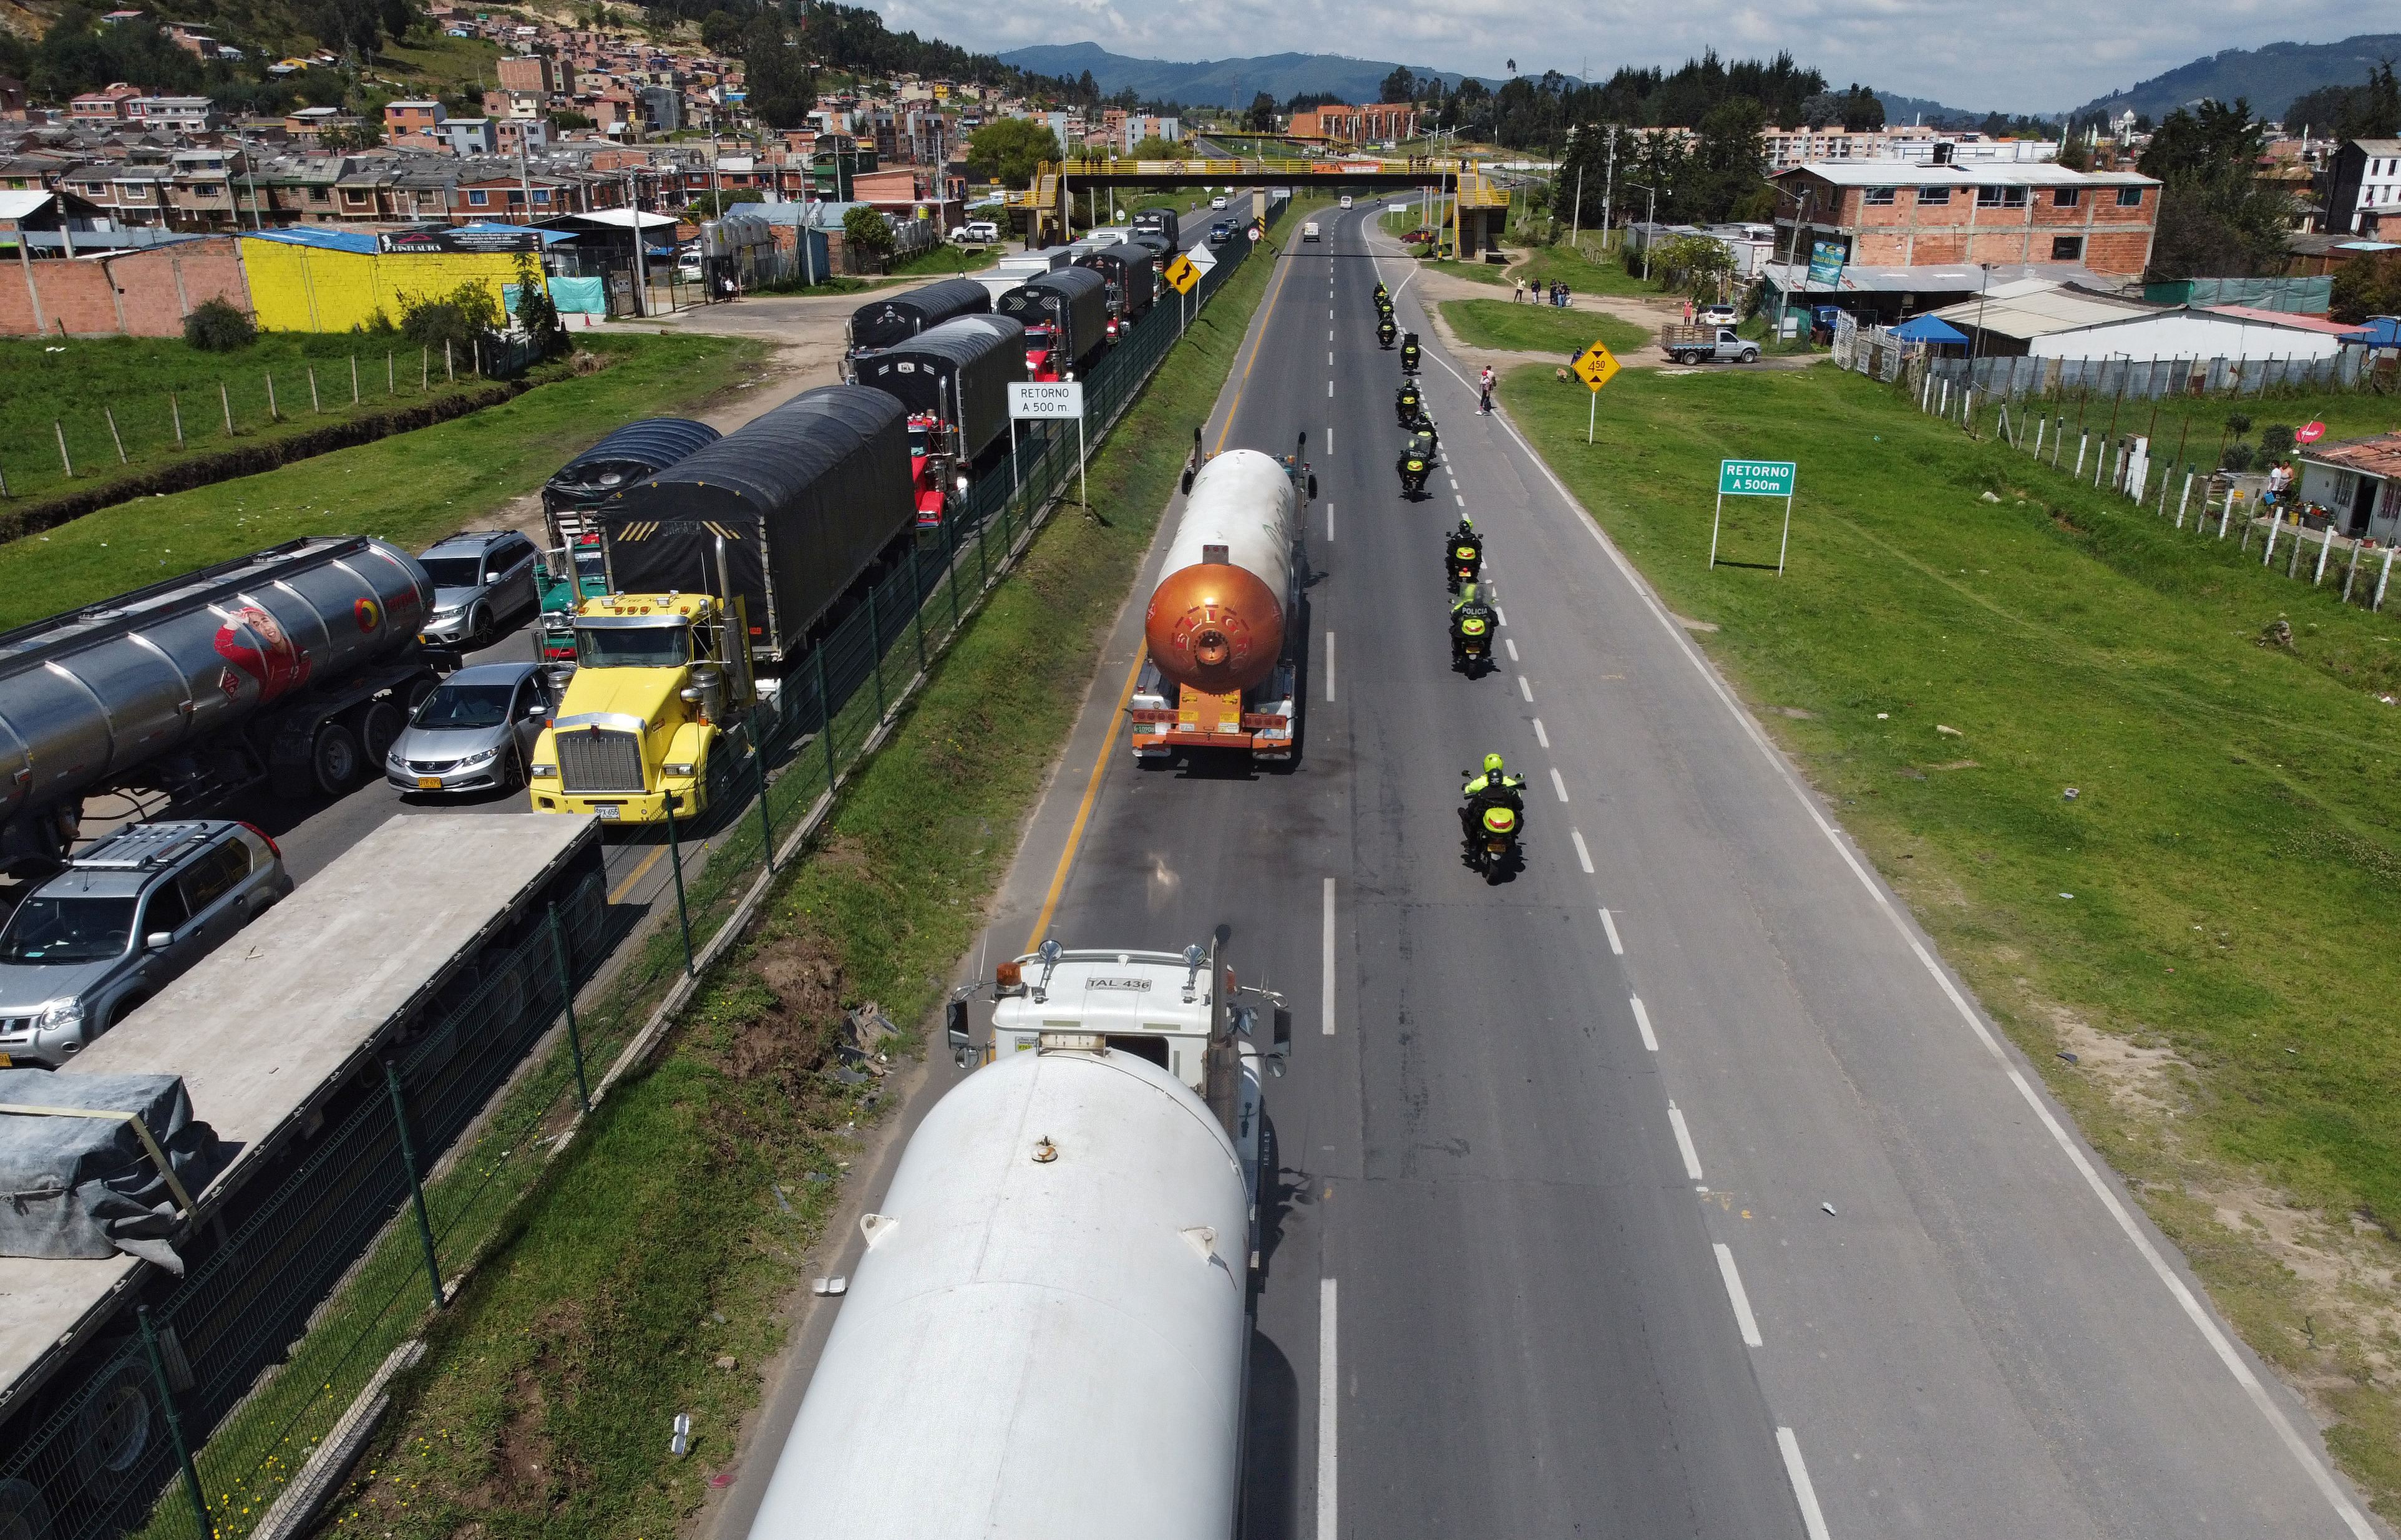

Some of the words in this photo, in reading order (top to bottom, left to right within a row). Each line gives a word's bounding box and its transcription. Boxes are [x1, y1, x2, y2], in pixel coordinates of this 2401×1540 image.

[1021, 388, 1069, 398] RETORNO
[1022, 402, 1030, 412] A
[1033, 402, 1054, 412] 500
[1726, 465, 1789, 477] RETORNO
[1732, 479, 1741, 489] A
[1745, 479, 1780, 490] 500m
[1462, 607, 1488, 615] POLICIA
[1123, 980, 1149, 989] 436
